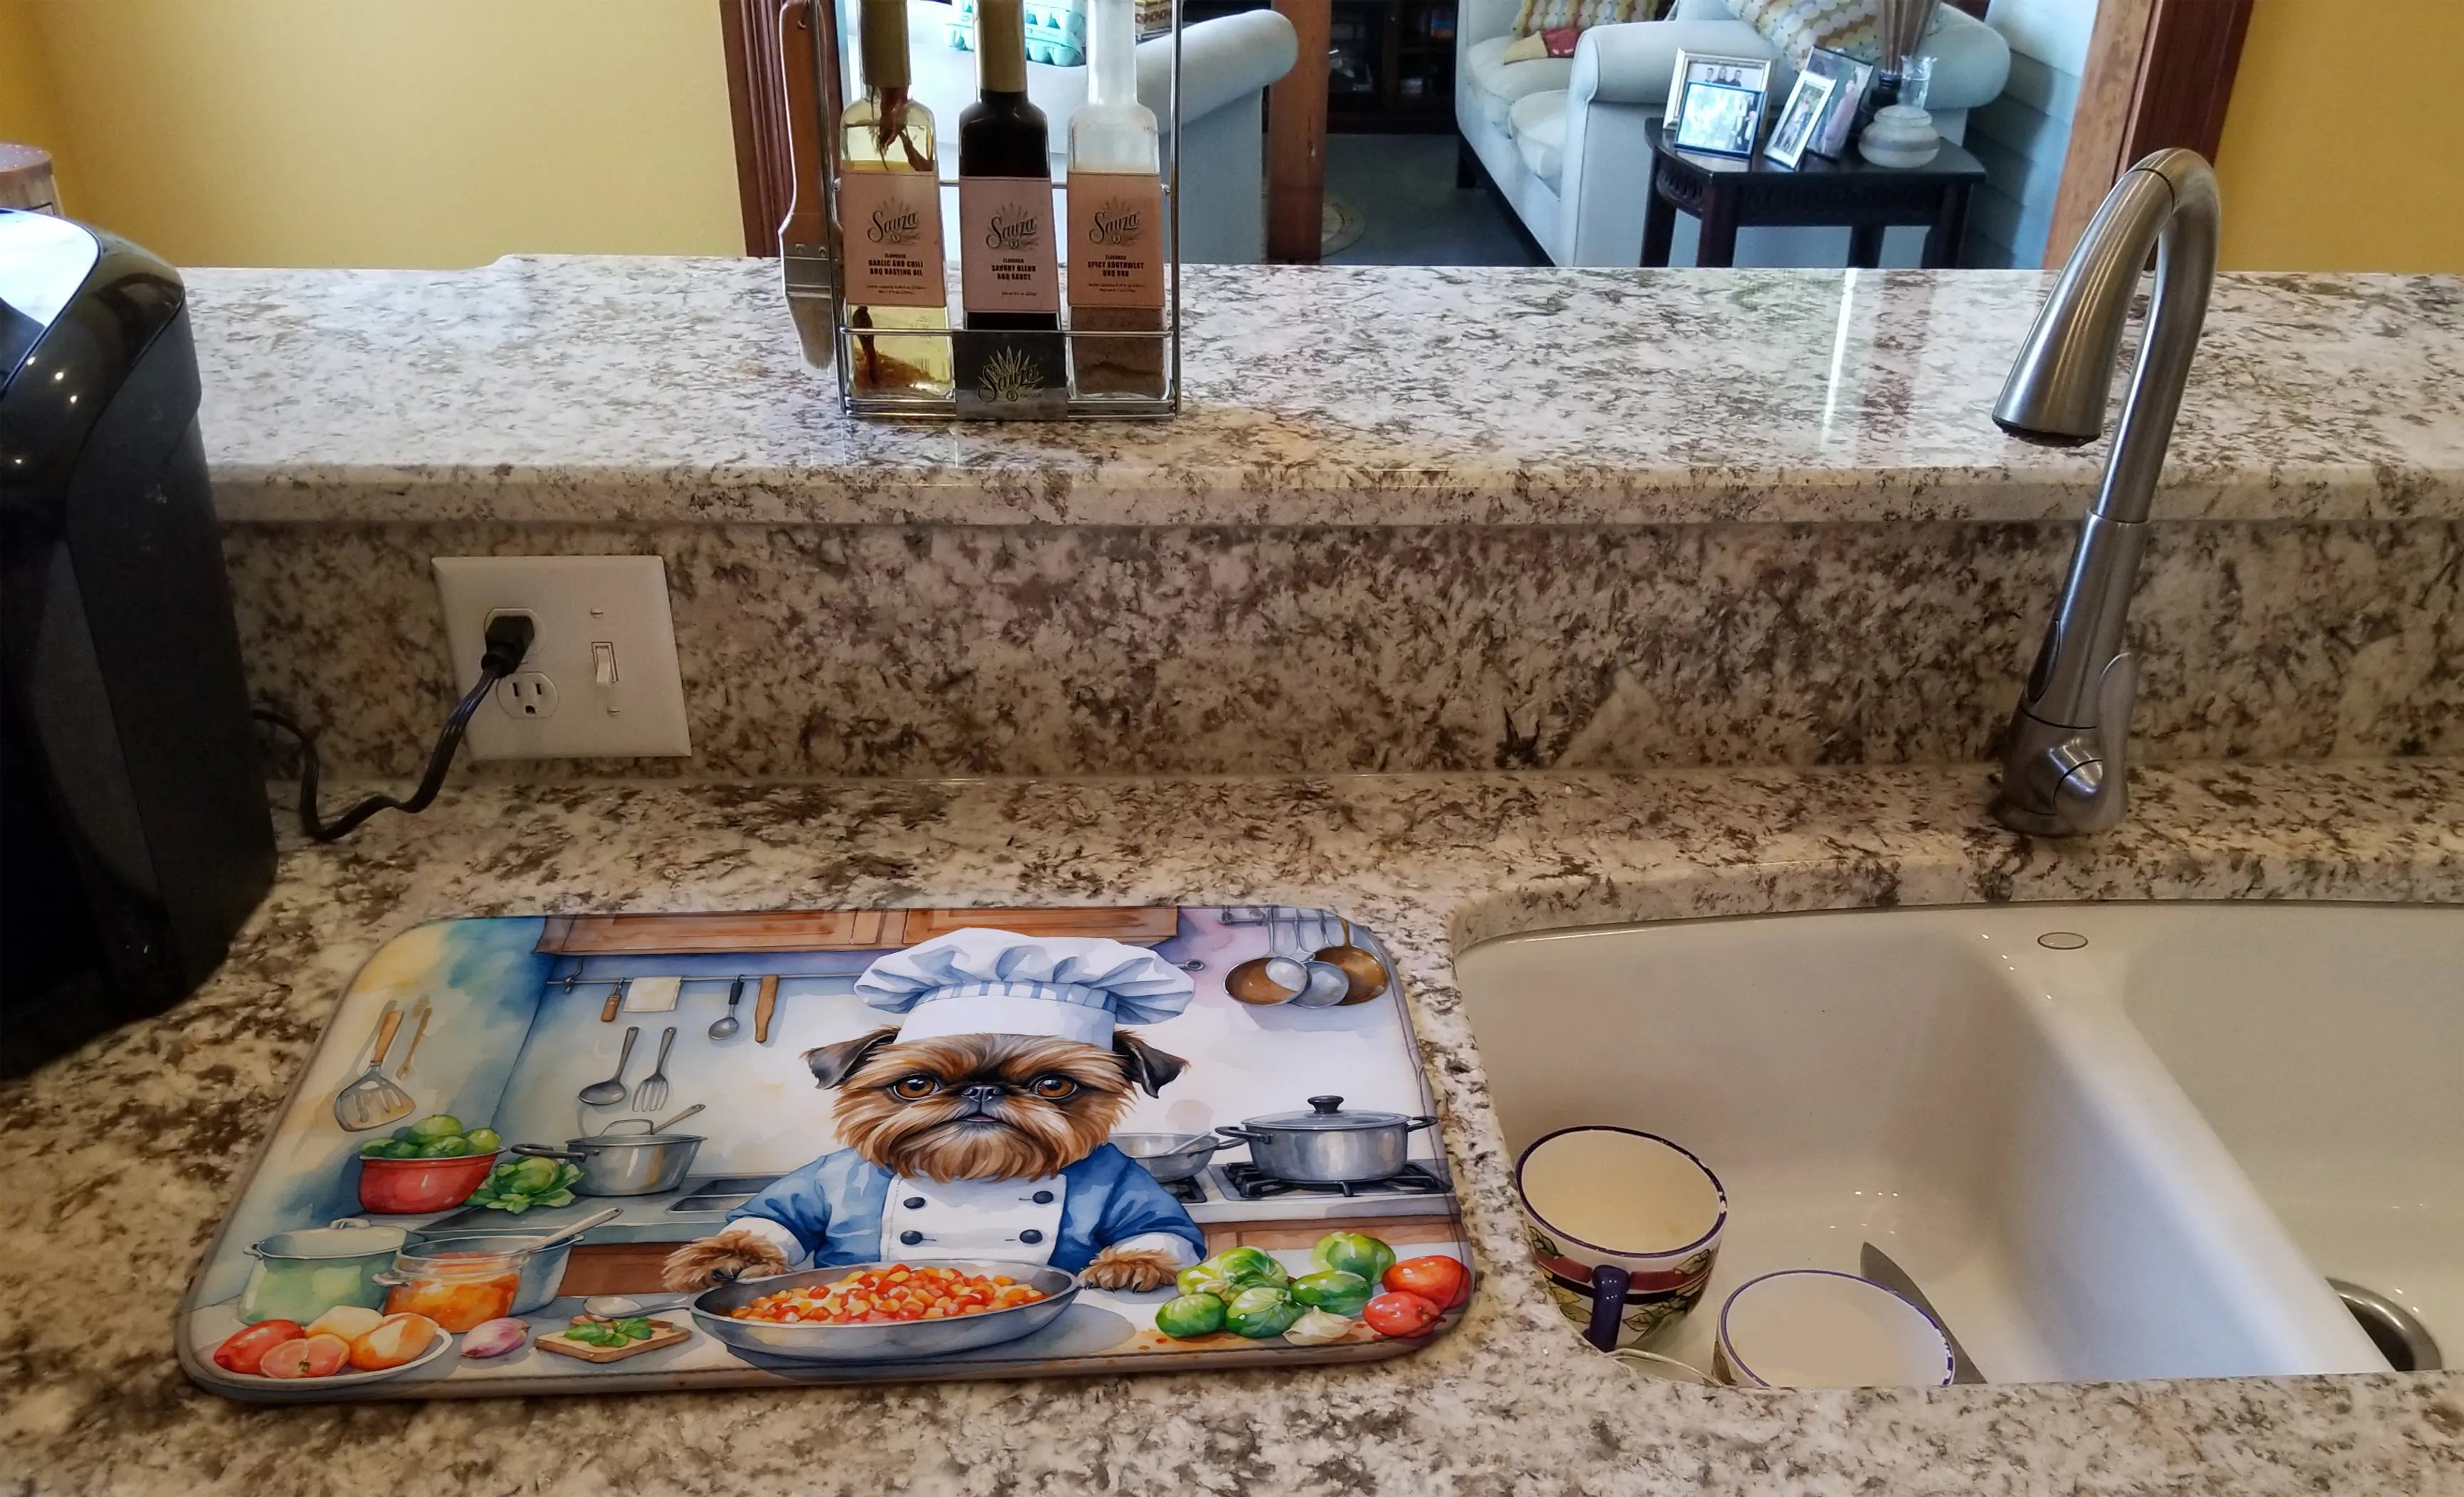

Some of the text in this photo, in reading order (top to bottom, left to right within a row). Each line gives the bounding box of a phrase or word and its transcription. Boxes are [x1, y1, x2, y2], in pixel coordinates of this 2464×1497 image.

[867, 210, 918, 242] Sauza
[986, 216, 1036, 249] Sauza
[1088, 211, 1139, 244] Sauza
[977, 364, 1043, 403] Sauza
